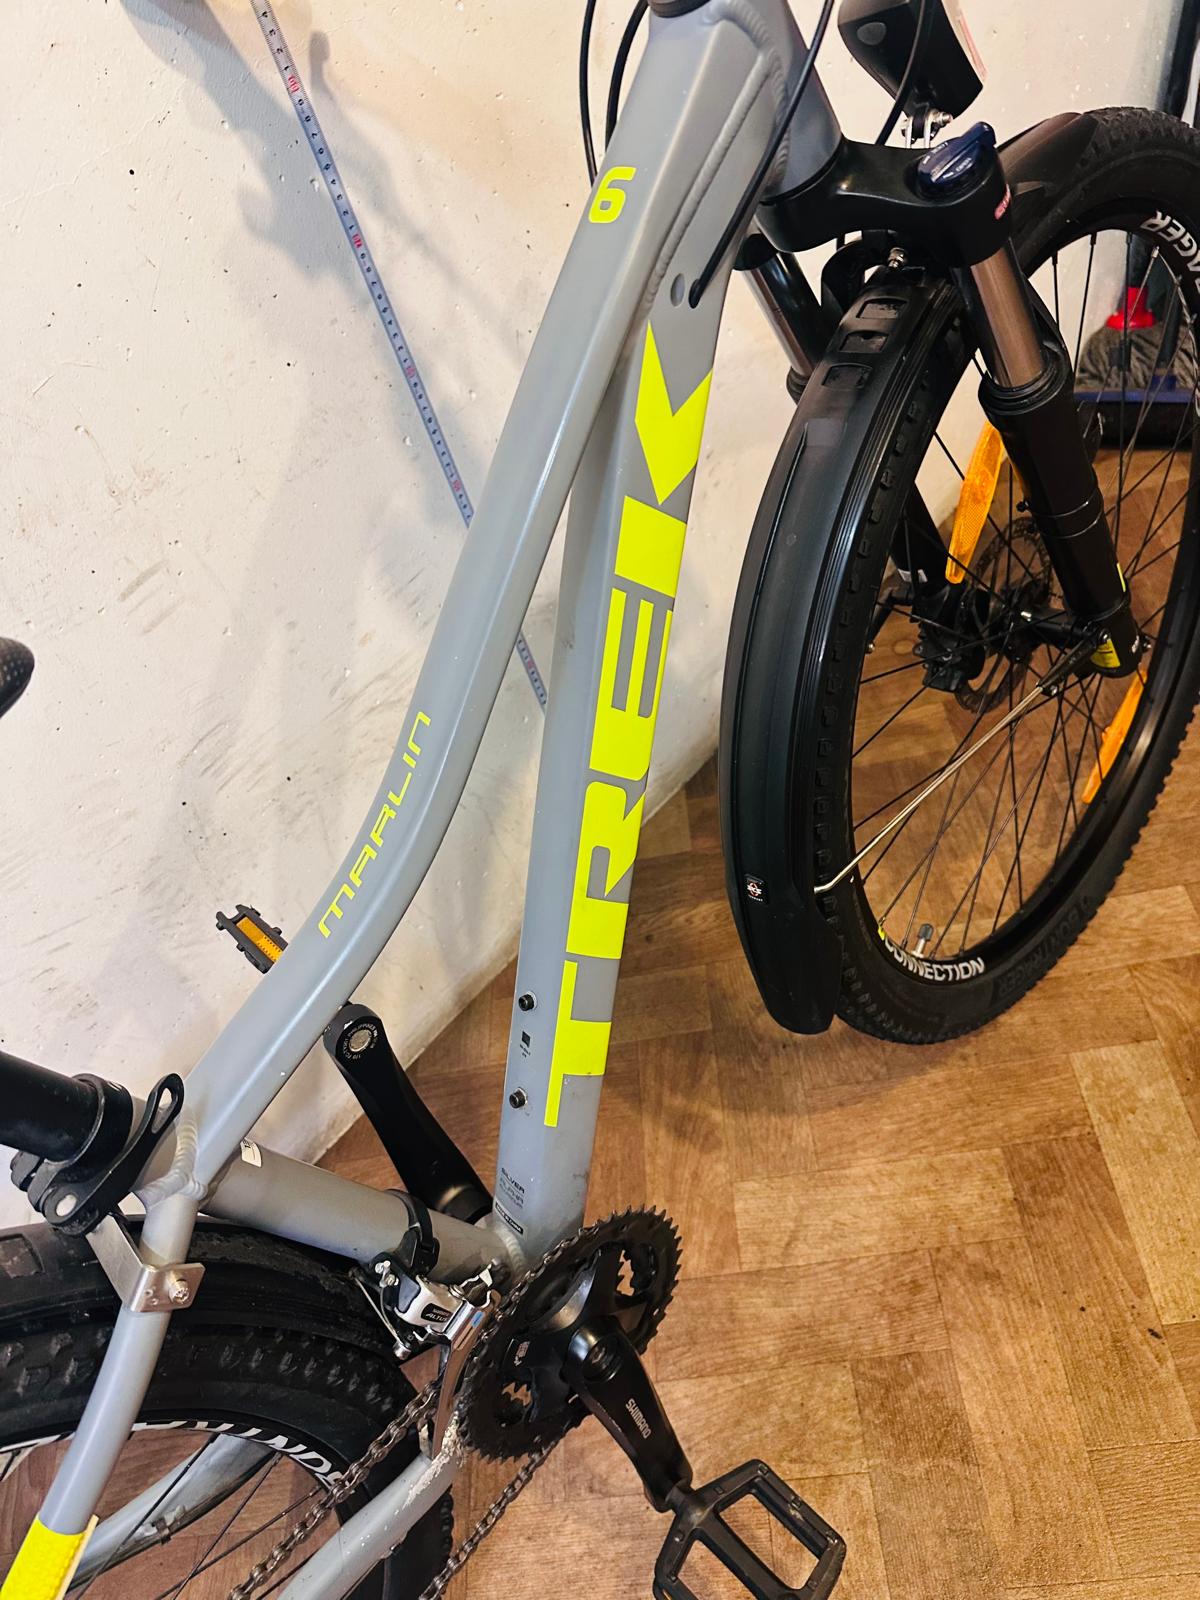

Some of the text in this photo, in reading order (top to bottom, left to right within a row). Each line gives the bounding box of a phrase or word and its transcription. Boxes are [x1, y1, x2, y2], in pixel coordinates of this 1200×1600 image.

[588, 166, 637, 224] 6
[543, 319, 714, 1128] TREK
[884, 936, 985, 982] CONNECTION
[625, 1398, 652, 1439] SHIMANO
